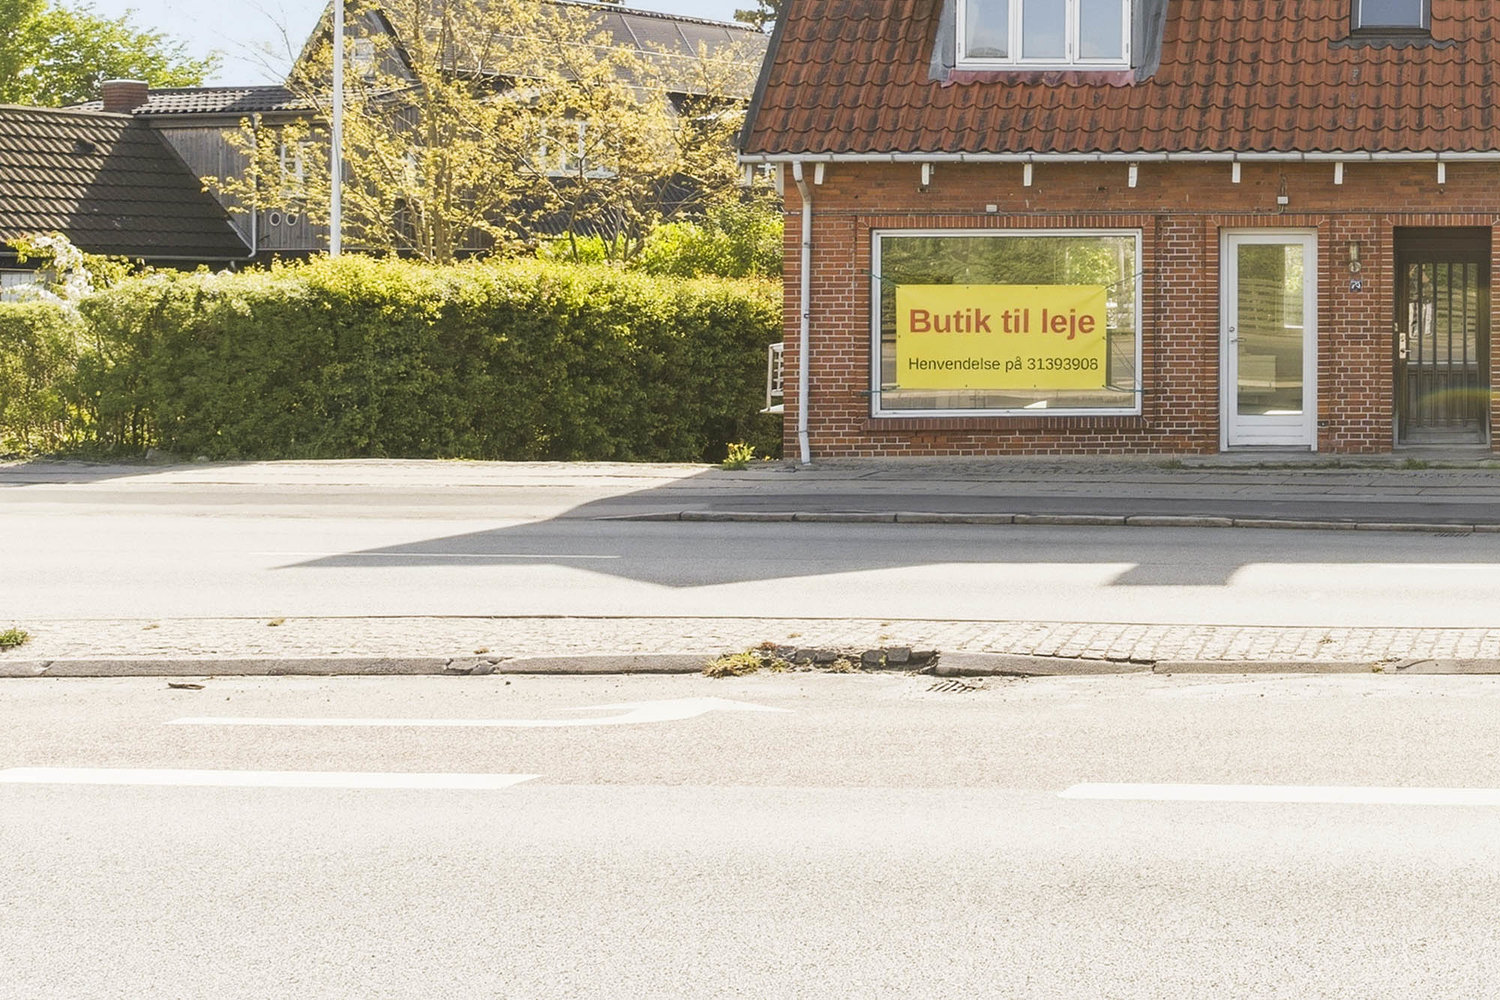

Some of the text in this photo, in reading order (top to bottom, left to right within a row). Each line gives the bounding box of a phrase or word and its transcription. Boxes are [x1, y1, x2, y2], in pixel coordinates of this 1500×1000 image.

[909, 308, 1095, 340] Butik til leje
[908, 357, 1000, 370] Henvendelse
[1005, 356, 1022, 373] på
